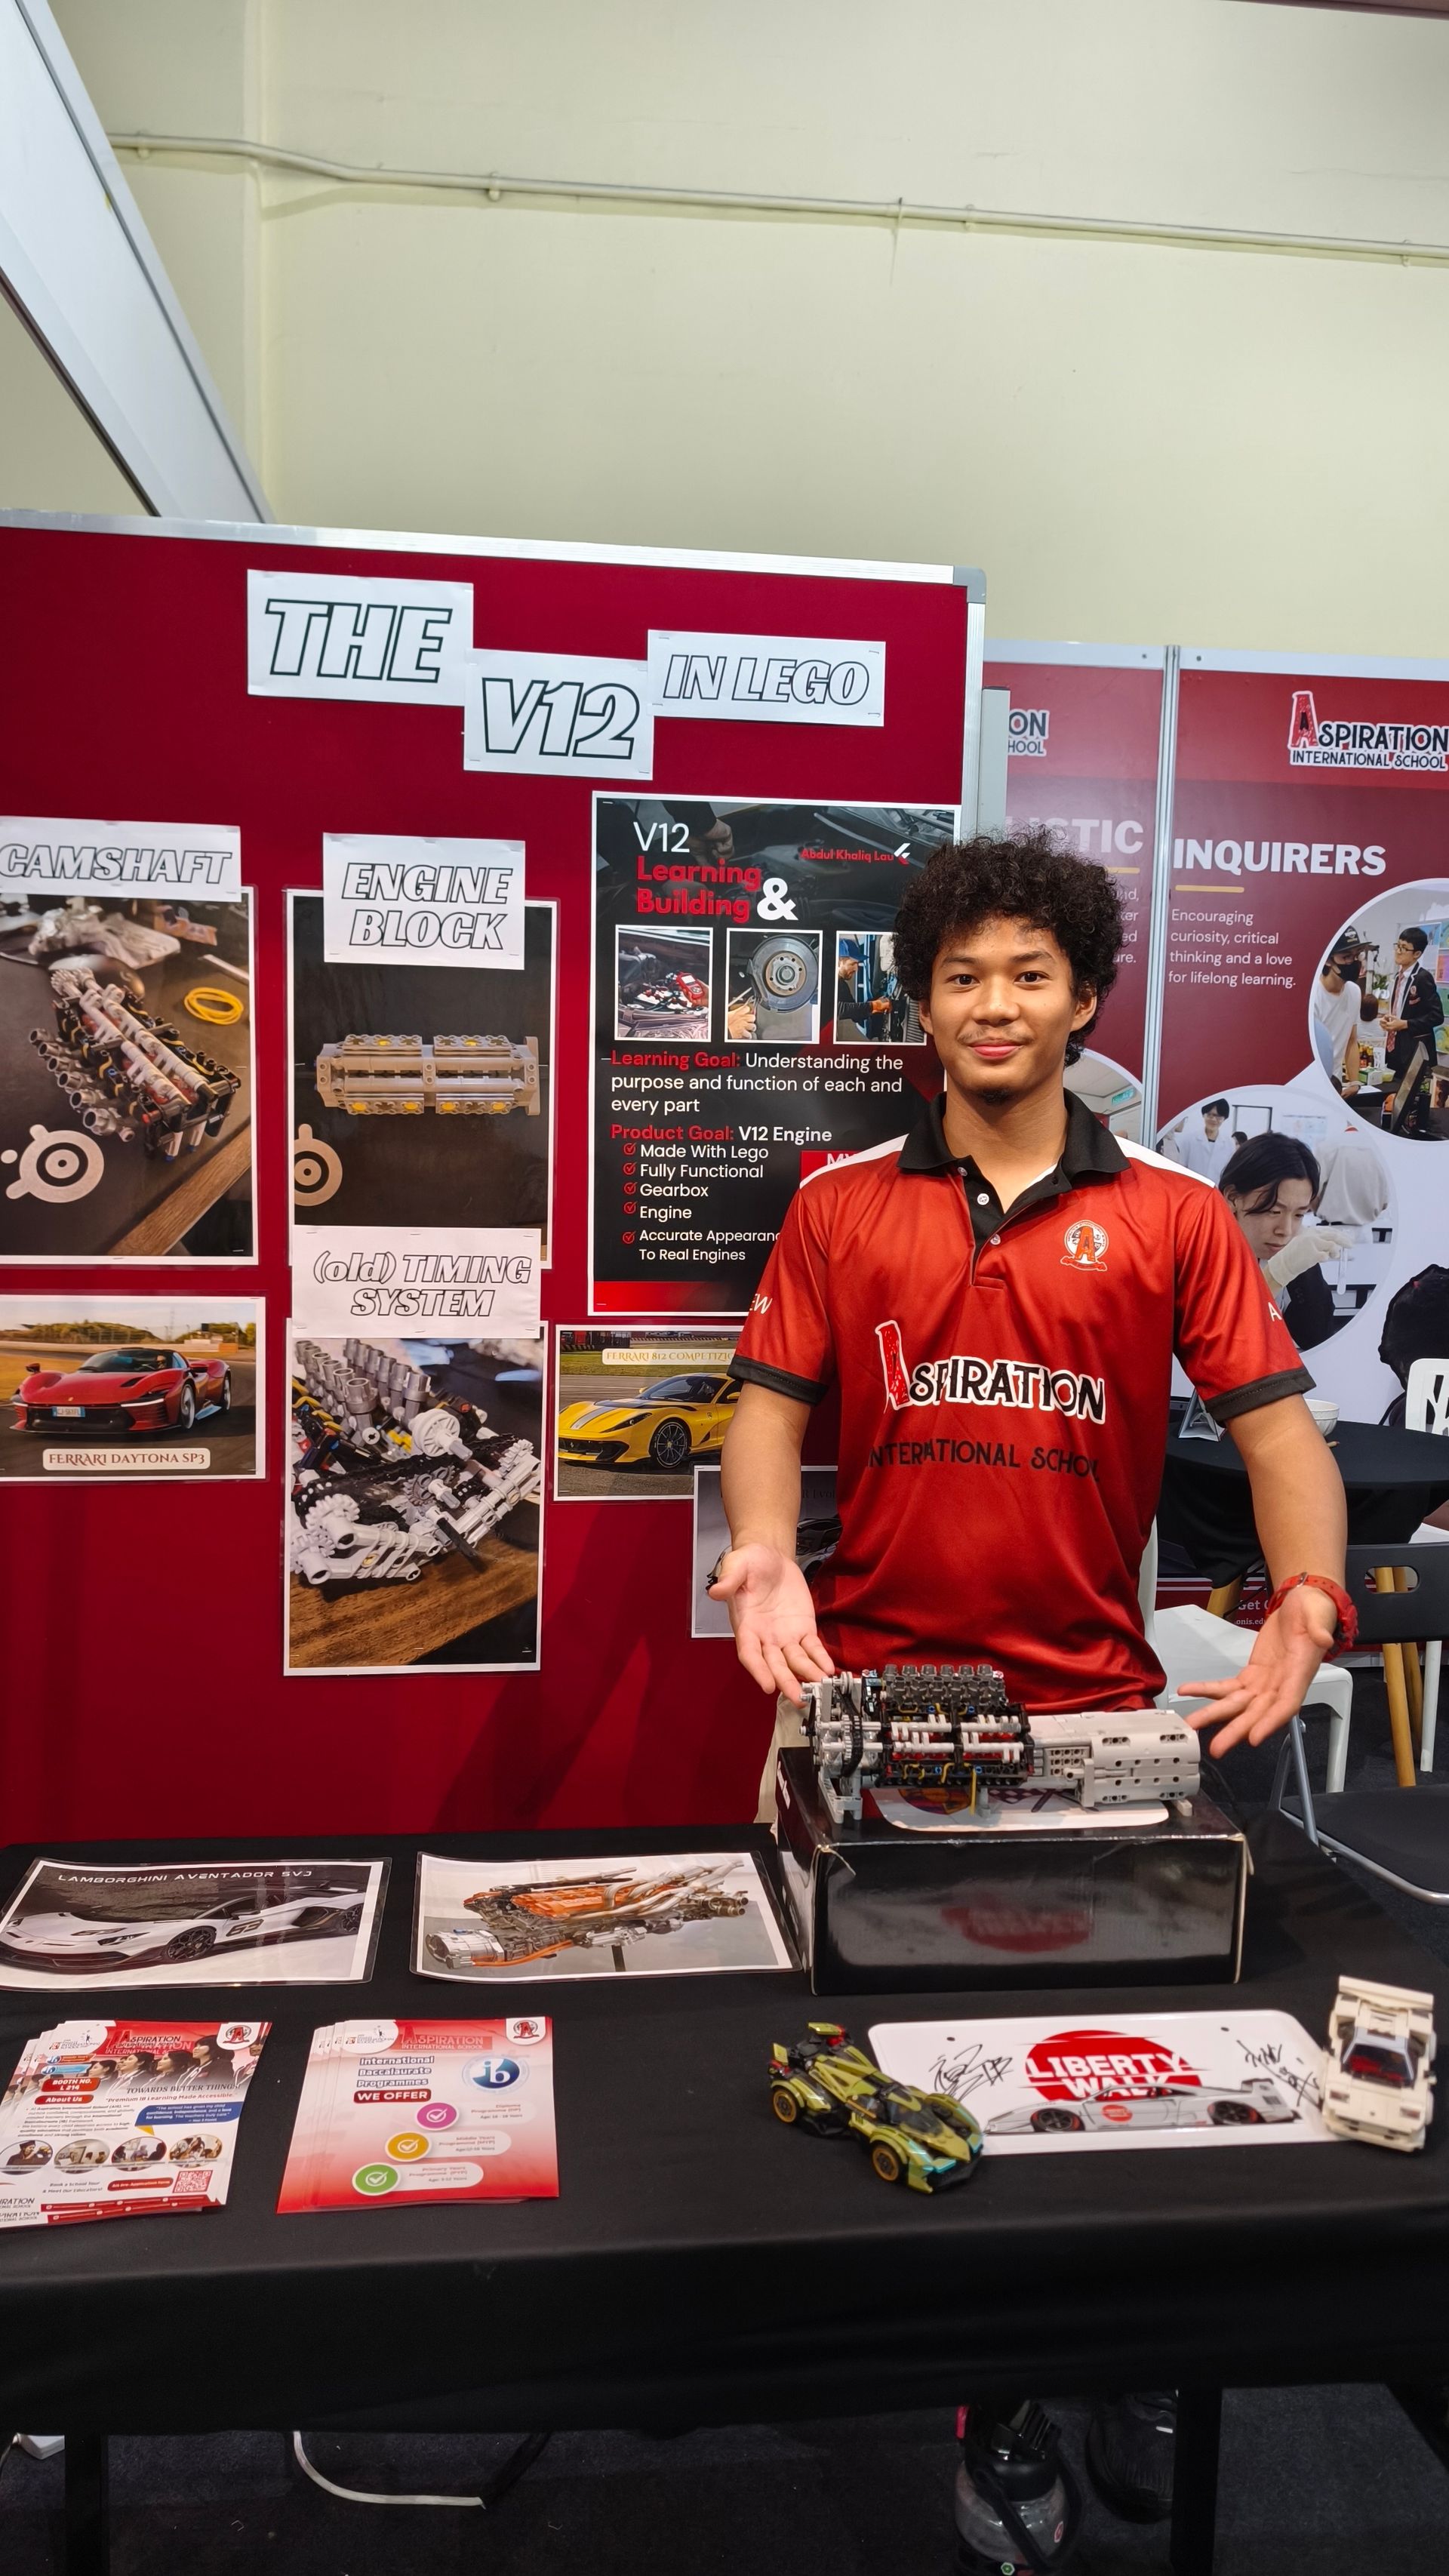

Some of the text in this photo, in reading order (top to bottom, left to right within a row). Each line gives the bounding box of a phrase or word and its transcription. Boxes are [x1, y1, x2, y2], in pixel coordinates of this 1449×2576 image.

[265, 598, 454, 684] THE
[663, 654, 870, 706] IN LEGO
[481, 676, 640, 760] V12
[1287, 691, 1449, 752] ASPIRATION
[1292, 749, 1446, 769] INTERNATIONAL SCHOOL
[632, 821, 691, 854] V12
[0, 843, 232, 885] CAMSHAFT
[801, 848, 894, 864] Abdul Khaliq Lau
[1173, 839, 1387, 877] INQUIRERS
[341, 862, 514, 904] ENGINE
[637, 855, 762, 892] Learning
[636, 877, 799, 925] Building &
[1172, 908, 1254, 927] Encouraging
[349, 909, 508, 950] BLOCK
[1171, 930, 1280, 947] curiosity, critical
[1170, 950, 1293, 968] thinking and a love
[1168, 970, 1297, 989] for lifelong learning.
[611, 1050, 904, 1072] Learning Goal: Understanding the
[611, 1073, 903, 1093] purpose and function of each and
[611, 1098, 700, 1116] every part
[611, 1124, 833, 1146] Product Goal: V12 Engine
[640, 1144, 769, 1163] Made With Lego
[640, 1164, 764, 1181] Fully Functional
[640, 1183, 709, 1198] Gearbox
[640, 1205, 692, 1223] Engine
[639, 1229, 703, 1242] Accurate
[639, 1248, 746, 1264] To Real Engines
[313, 1250, 531, 1284] (old) TIMING
[350, 1288, 495, 1318] SYSTEM
[607, 1352, 649, 1362] FERRARI
[49, 1453, 205, 1467] FERRARI DAYTONA SP3
[58, 1873, 168, 1885] LAMBORGHINI
[174, 1872, 275, 1881] AVENTADOR
[360, 2056, 435, 2066] International
[1026, 2052, 1186, 2078] LIBERTY
[126, 2086, 168, 2094] TOWARDS
[356, 2079, 429, 2088] Programmes
[357, 2091, 428, 2101] WE OFFER
